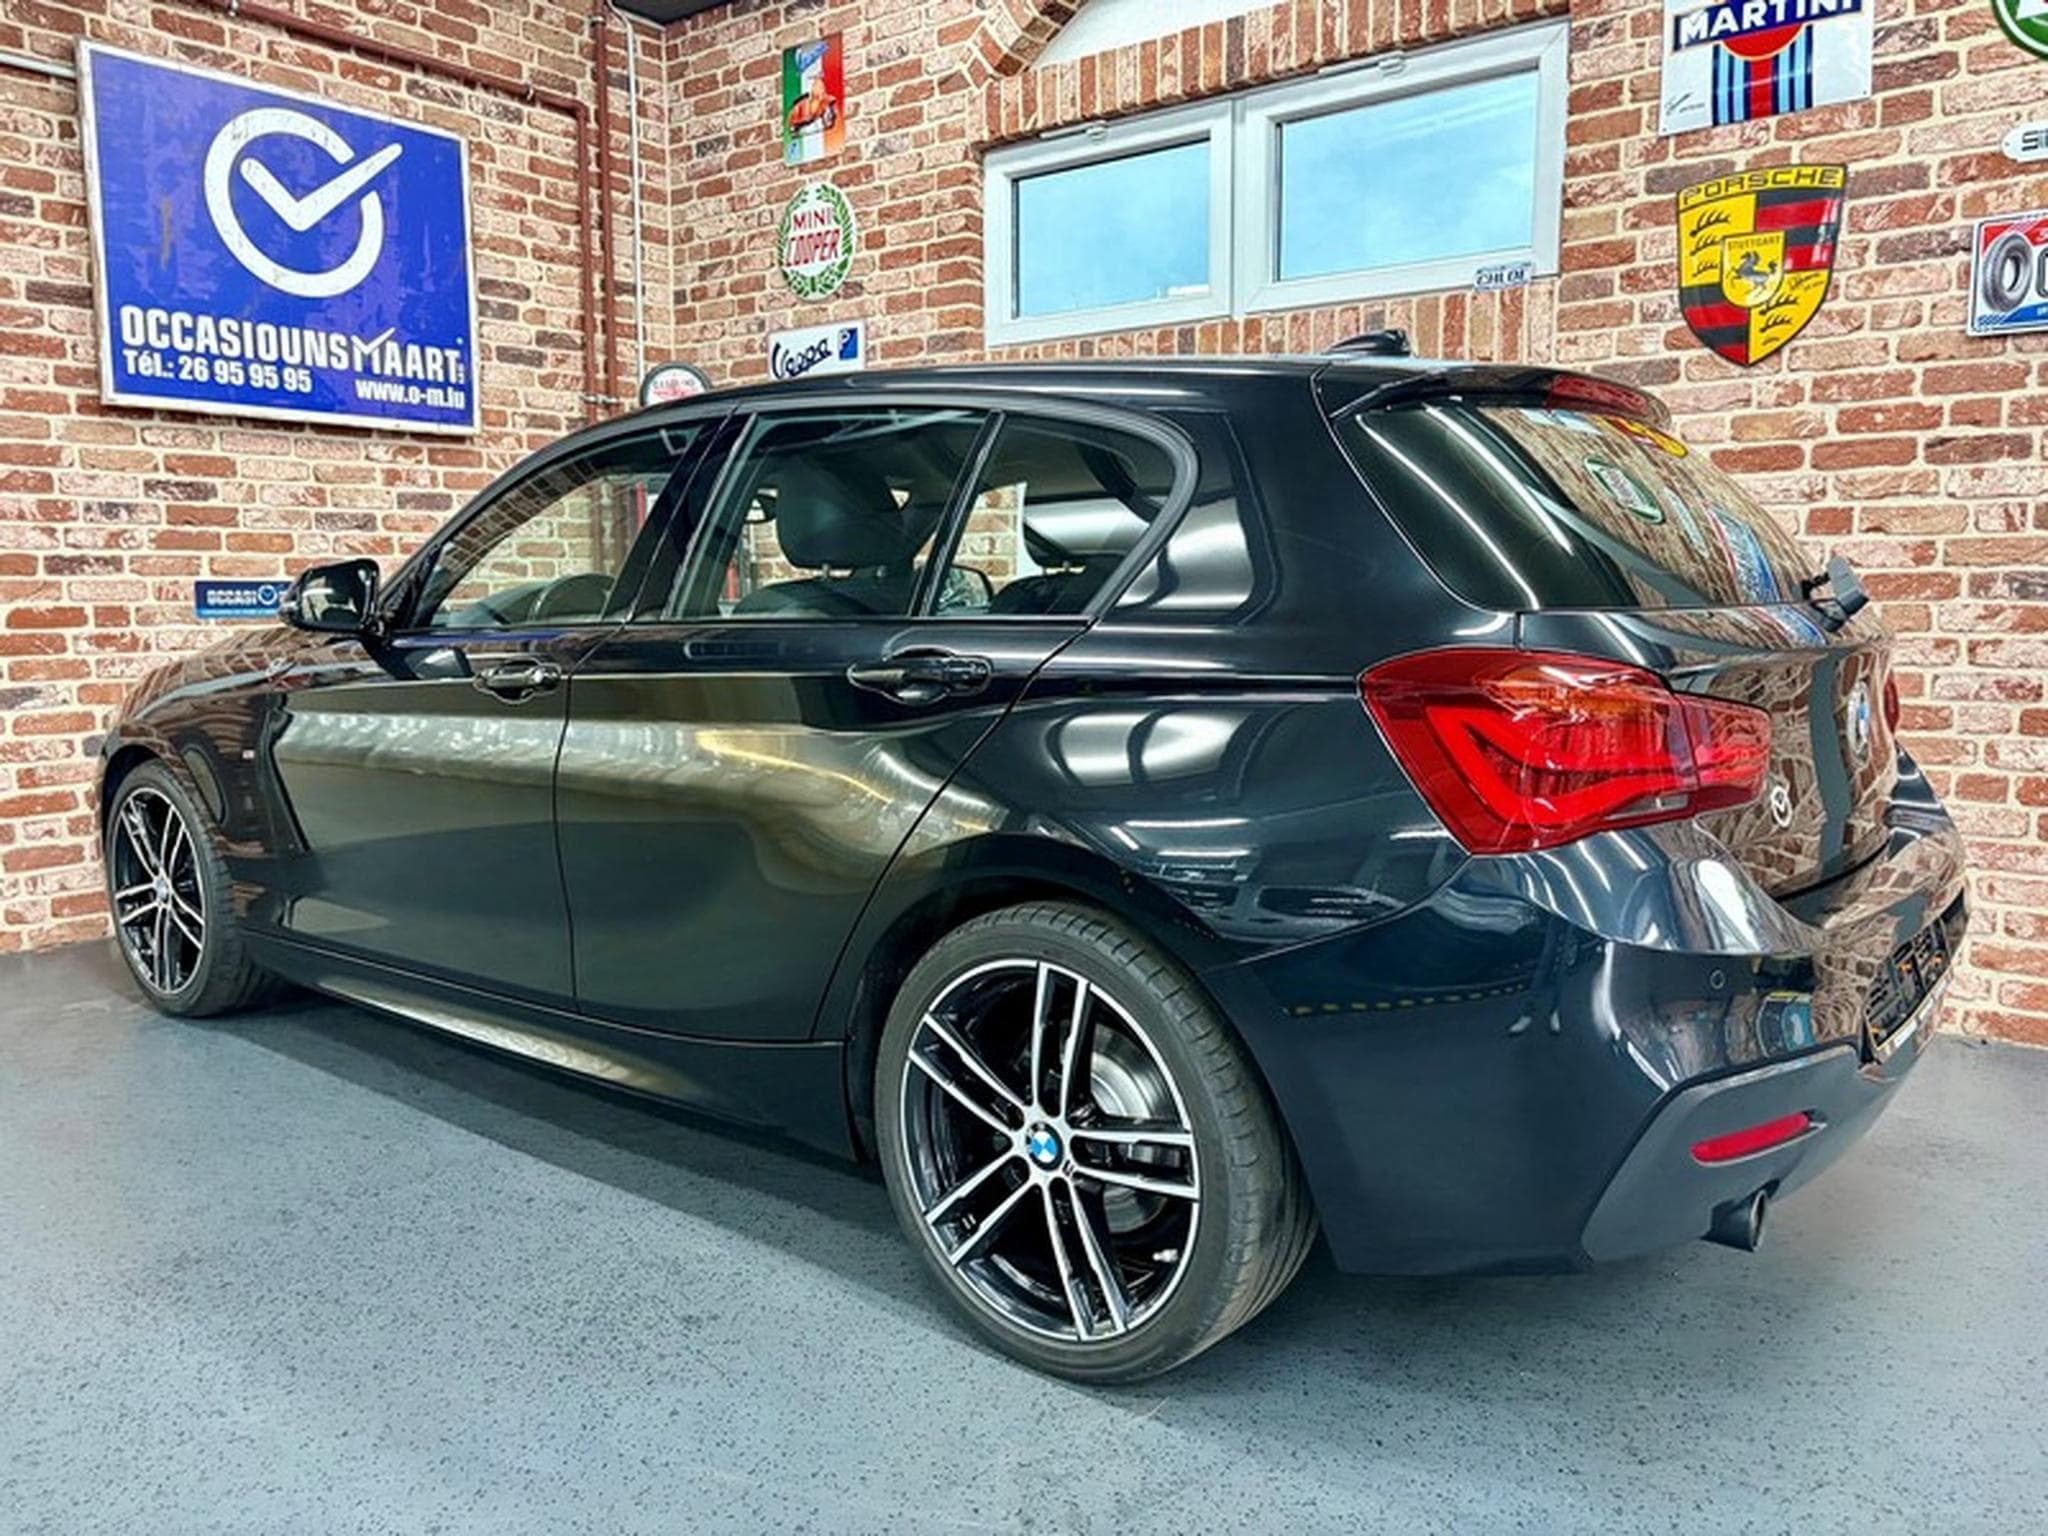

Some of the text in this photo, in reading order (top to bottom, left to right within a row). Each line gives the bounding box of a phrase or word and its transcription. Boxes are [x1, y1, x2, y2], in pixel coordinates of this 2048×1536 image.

[1682, 168, 1840, 206] PORSCHE
[793, 207, 832, 231] MINI
[786, 229, 841, 267] COOPER
[1727, 236, 1781, 250] STUTTGART
[123, 349, 312, 393] Tél.: 26 95 95 95
[355, 379, 465, 410] www.o-m.lu
